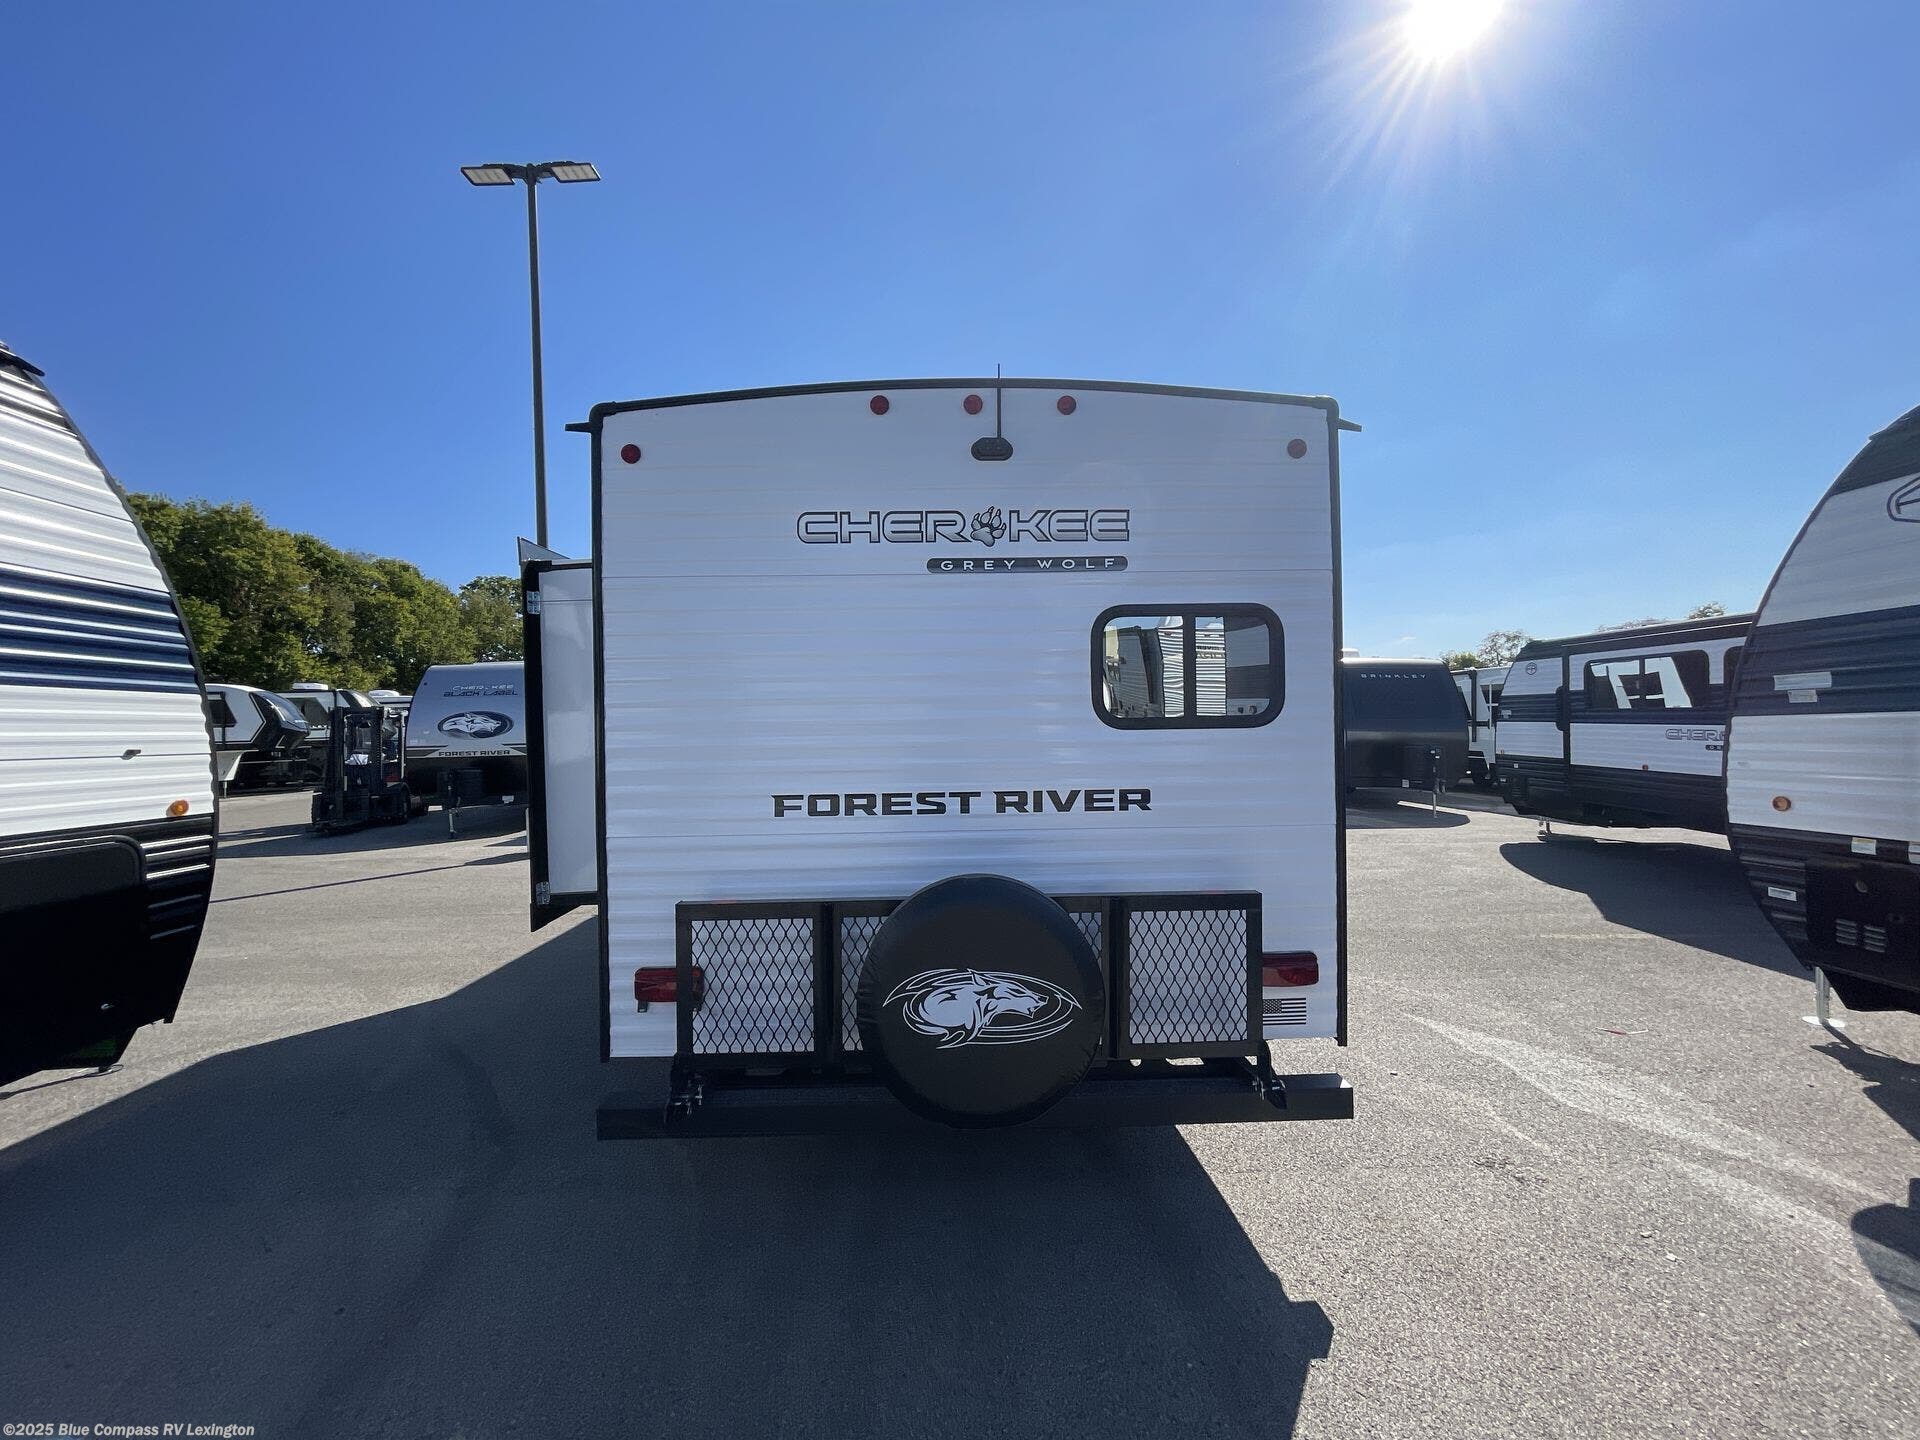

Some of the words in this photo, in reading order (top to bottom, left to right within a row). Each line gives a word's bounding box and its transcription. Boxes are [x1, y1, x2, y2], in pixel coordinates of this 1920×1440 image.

[796, 506, 1131, 548] CHEROKEE
[939, 559, 1016, 572] GREY
[1036, 557, 1117, 571] WOLF
[443, 690, 480, 698] BLACK
[483, 689, 519, 697] LABEL
[1665, 728, 1727, 742] CHER
[769, 791, 982, 818] FOREST
[992, 788, 1153, 814] RIVER
